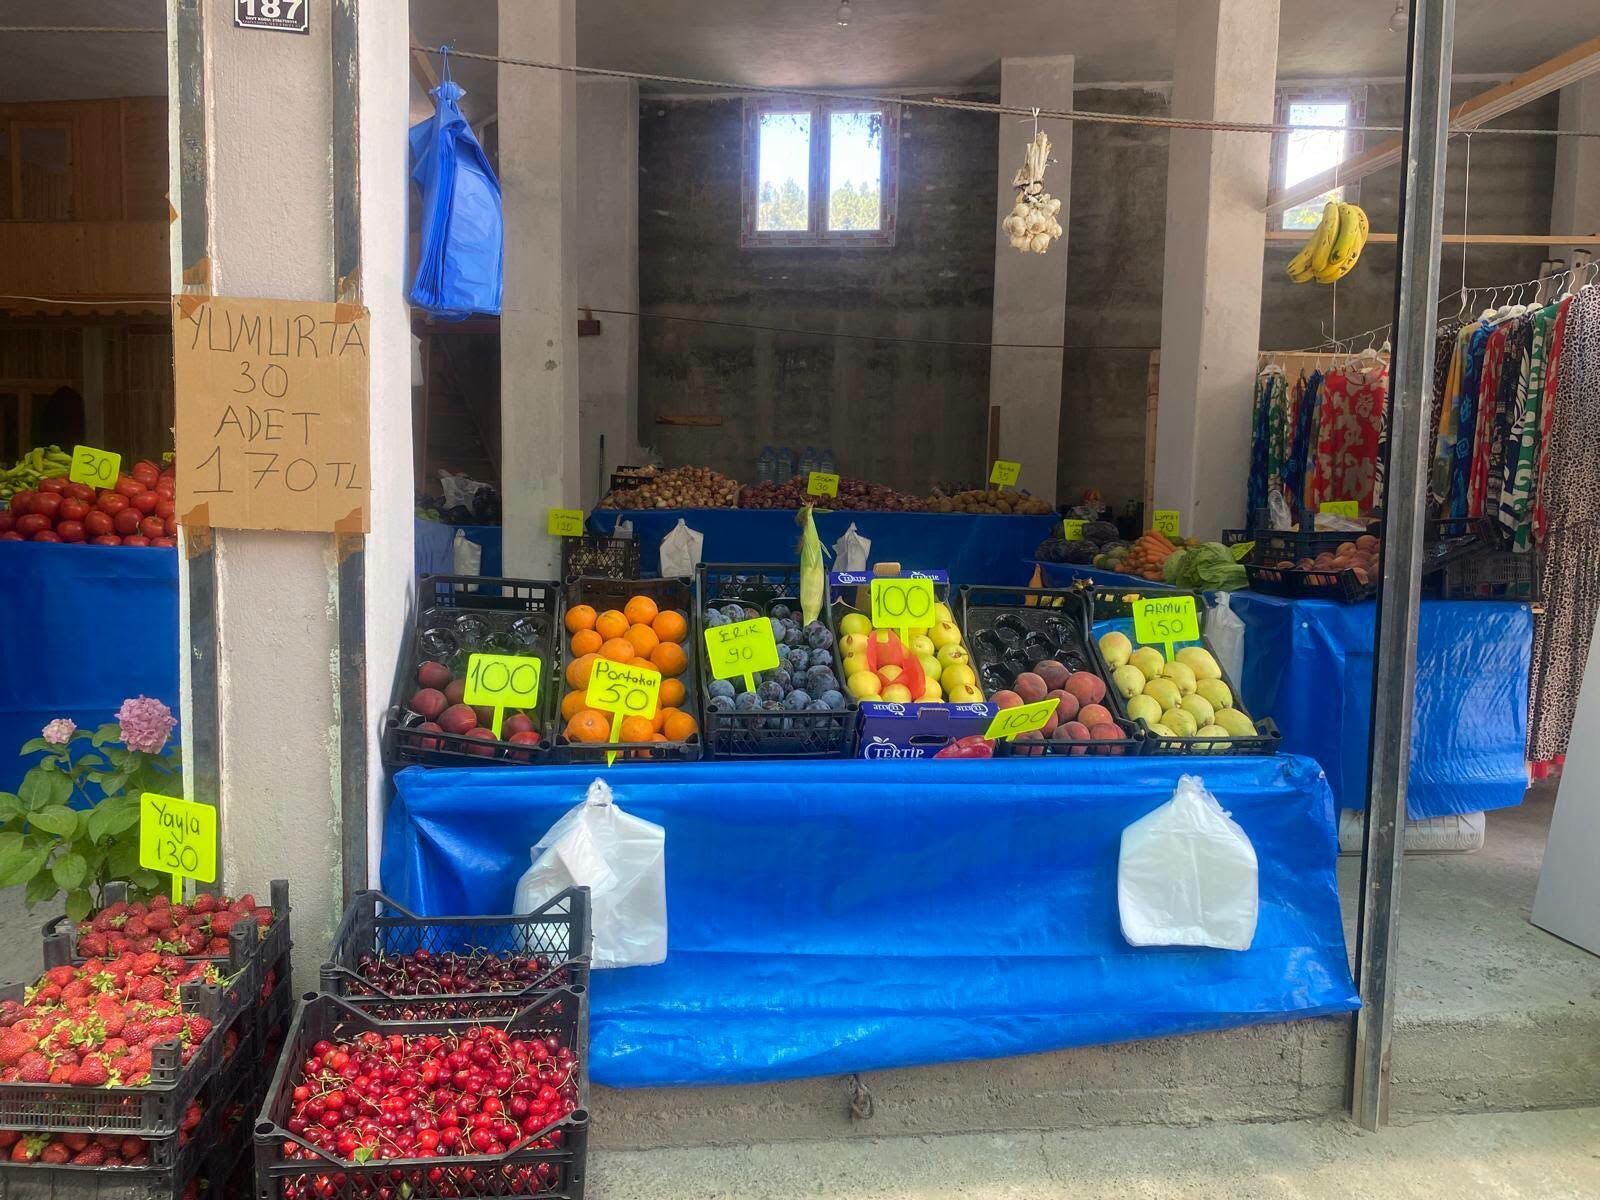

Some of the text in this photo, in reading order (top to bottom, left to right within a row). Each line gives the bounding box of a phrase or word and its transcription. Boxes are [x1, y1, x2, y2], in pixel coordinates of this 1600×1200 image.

[240, 0, 302, 19] 187
[177, 302, 366, 358] YUMURTA
[233, 361, 288, 397] 30
[214, 405, 320, 445] ADET
[80, 453, 112, 480] 30
[876, 584, 931, 617] 100
[1144, 600, 1191, 617] ARMUT
[1151, 619, 1184, 636] 150
[471, 658, 537, 694] 100
[598, 683, 649, 711] 50
[1002, 708, 1049, 730] 100
[151, 801, 200, 844] Yayla
[157, 838, 198, 872] 130
